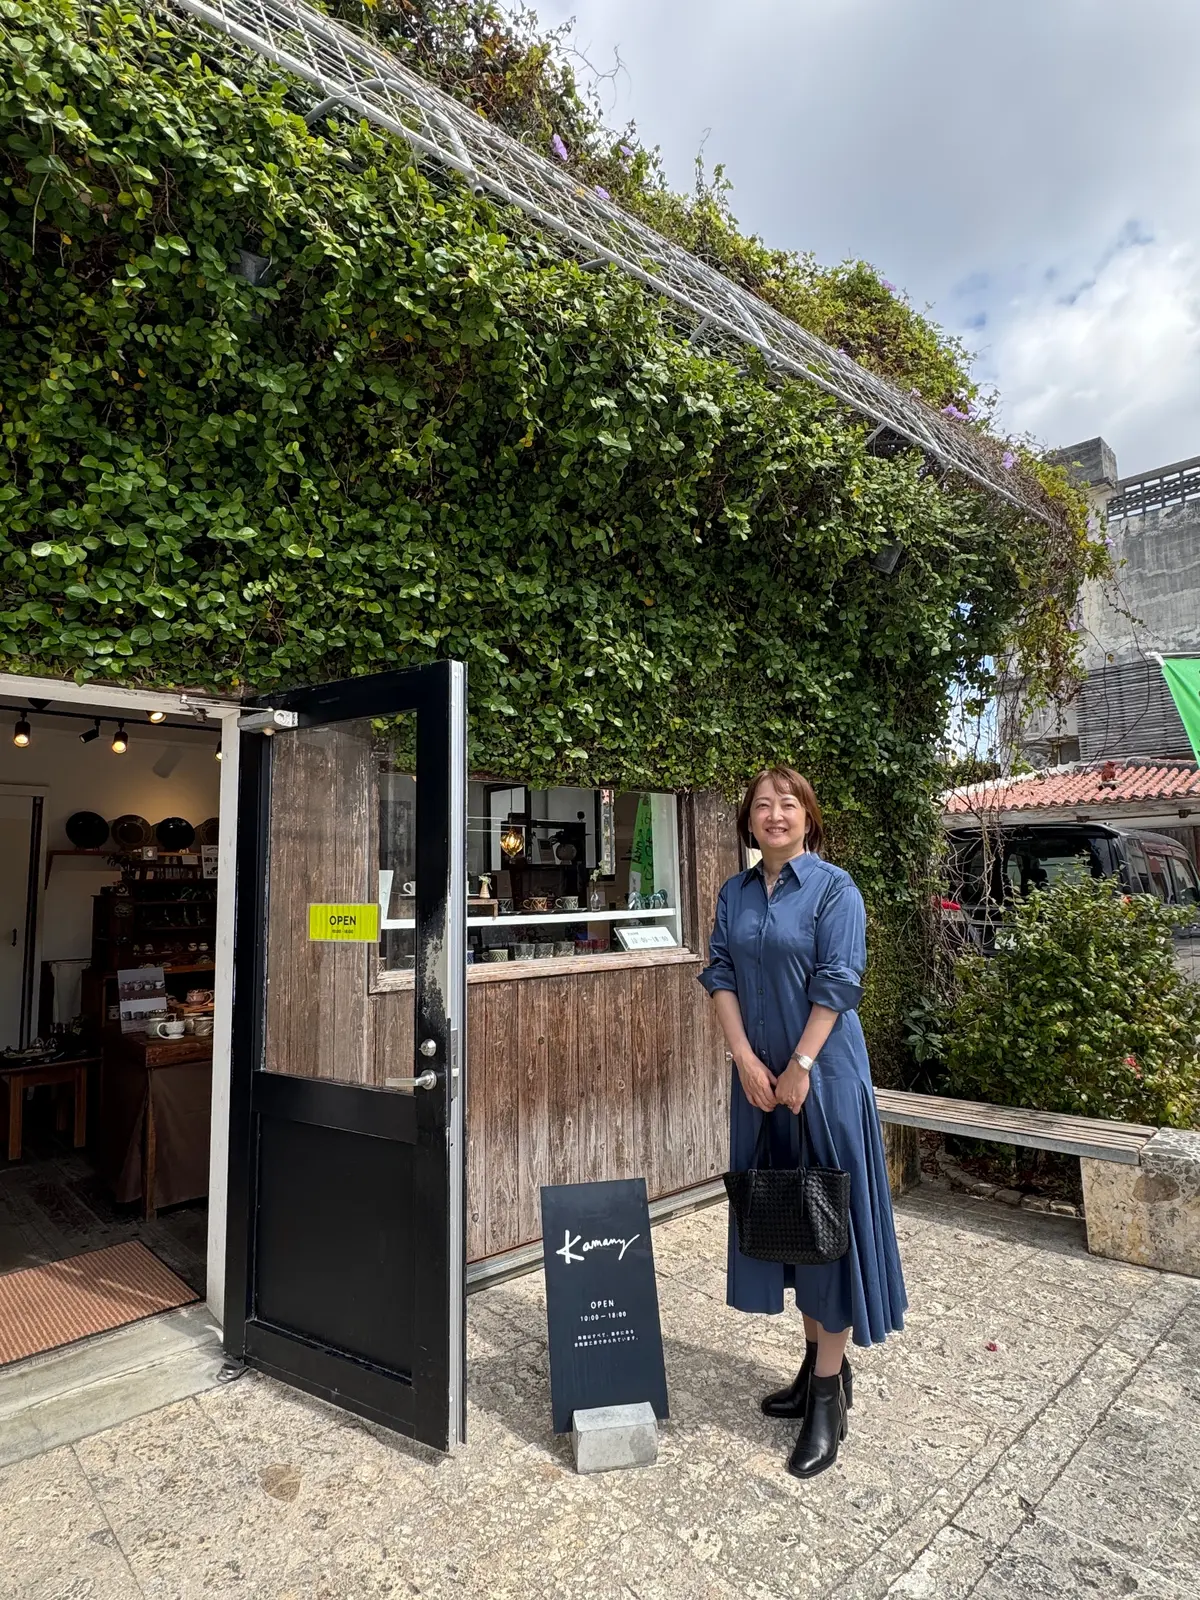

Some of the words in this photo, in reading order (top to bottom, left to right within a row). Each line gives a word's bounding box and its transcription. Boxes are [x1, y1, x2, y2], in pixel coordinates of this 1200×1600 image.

[329, 915, 357, 926] OPEN
[556, 1229, 641, 1264] Kamany
[590, 1299, 614, 1310] OPEN
